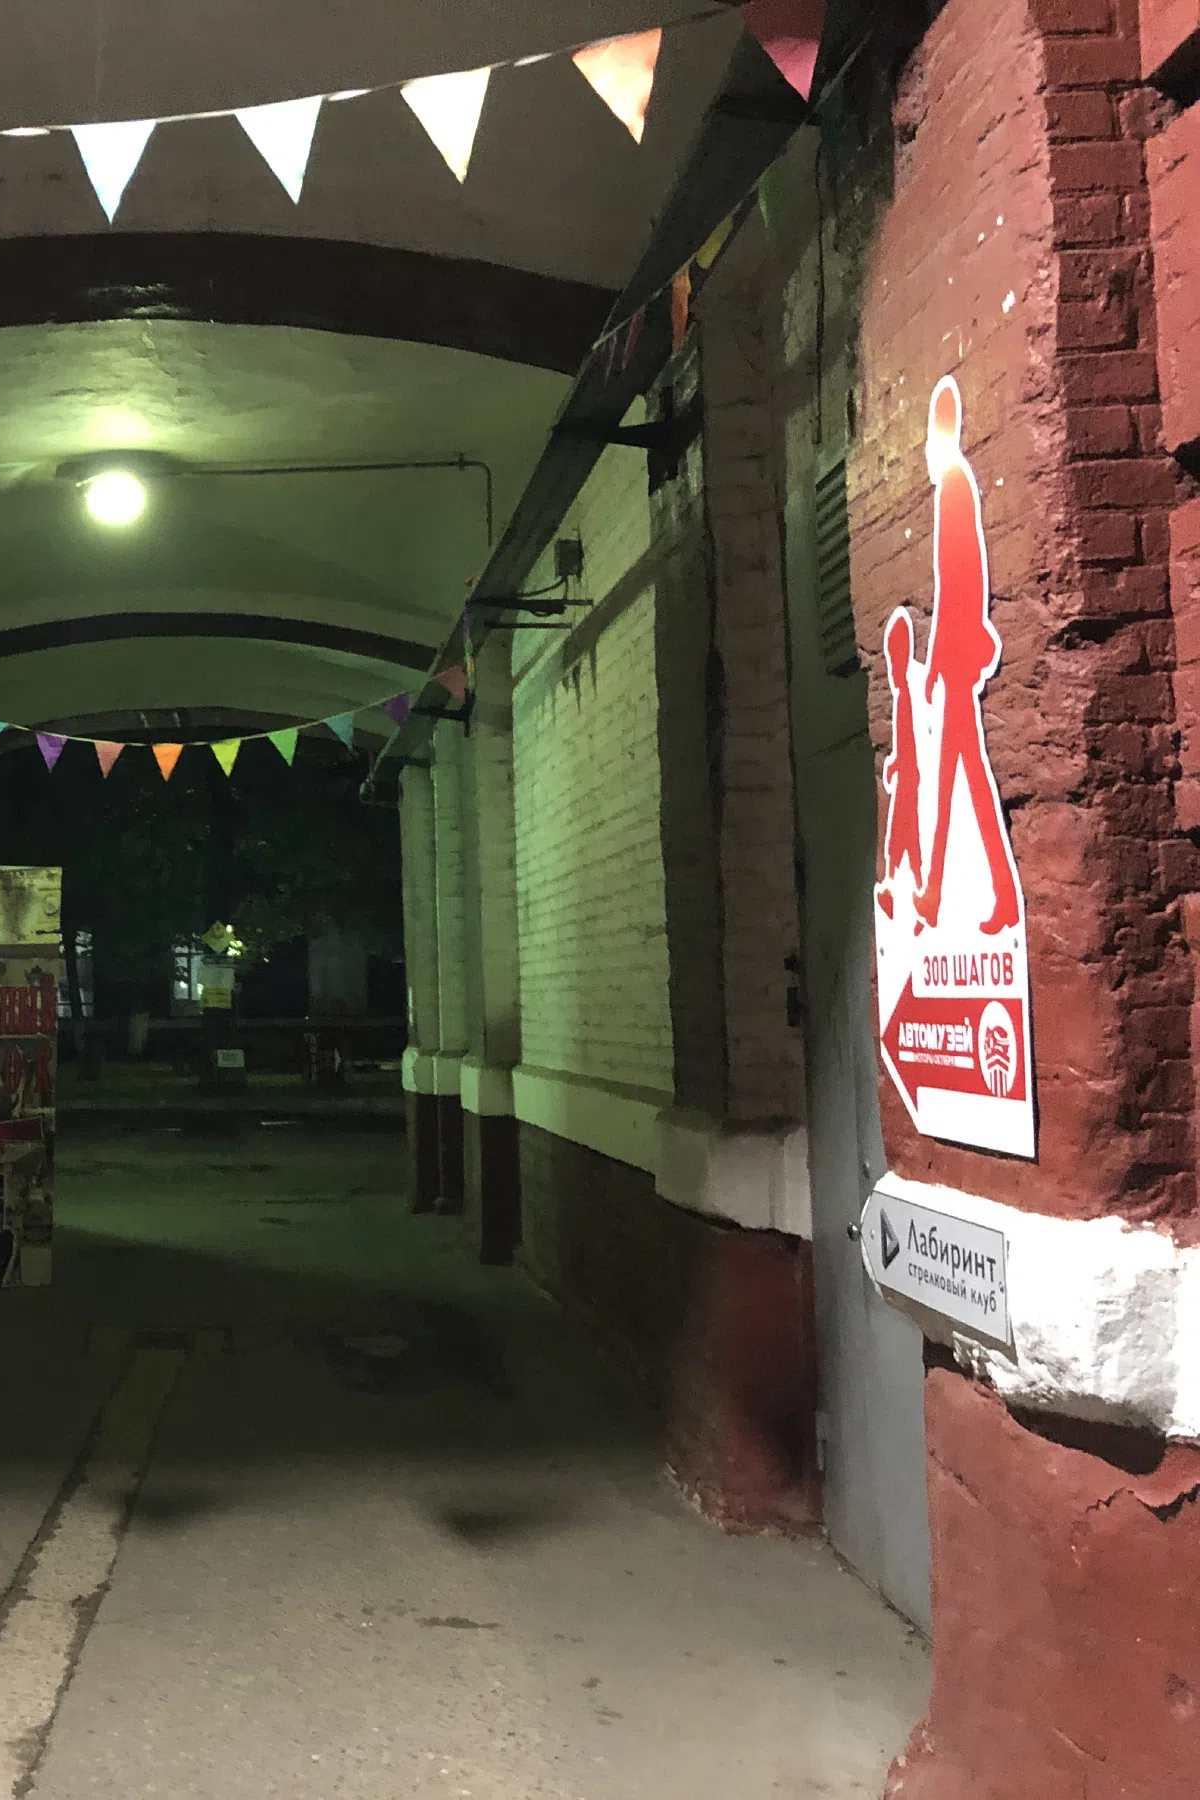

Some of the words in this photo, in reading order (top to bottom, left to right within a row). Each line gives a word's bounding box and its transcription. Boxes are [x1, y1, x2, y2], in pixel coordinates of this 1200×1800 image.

[923, 955, 948, 986] 300
[953, 952, 1014, 986] ШАГОВ
[899, 1017, 973, 1053] АВТОМУЗЕЙ
[907, 1218, 997, 1283] Лабиринт
[907, 1262, 968, 1300] стрелковый
[970, 1288, 997, 1315] клуб
